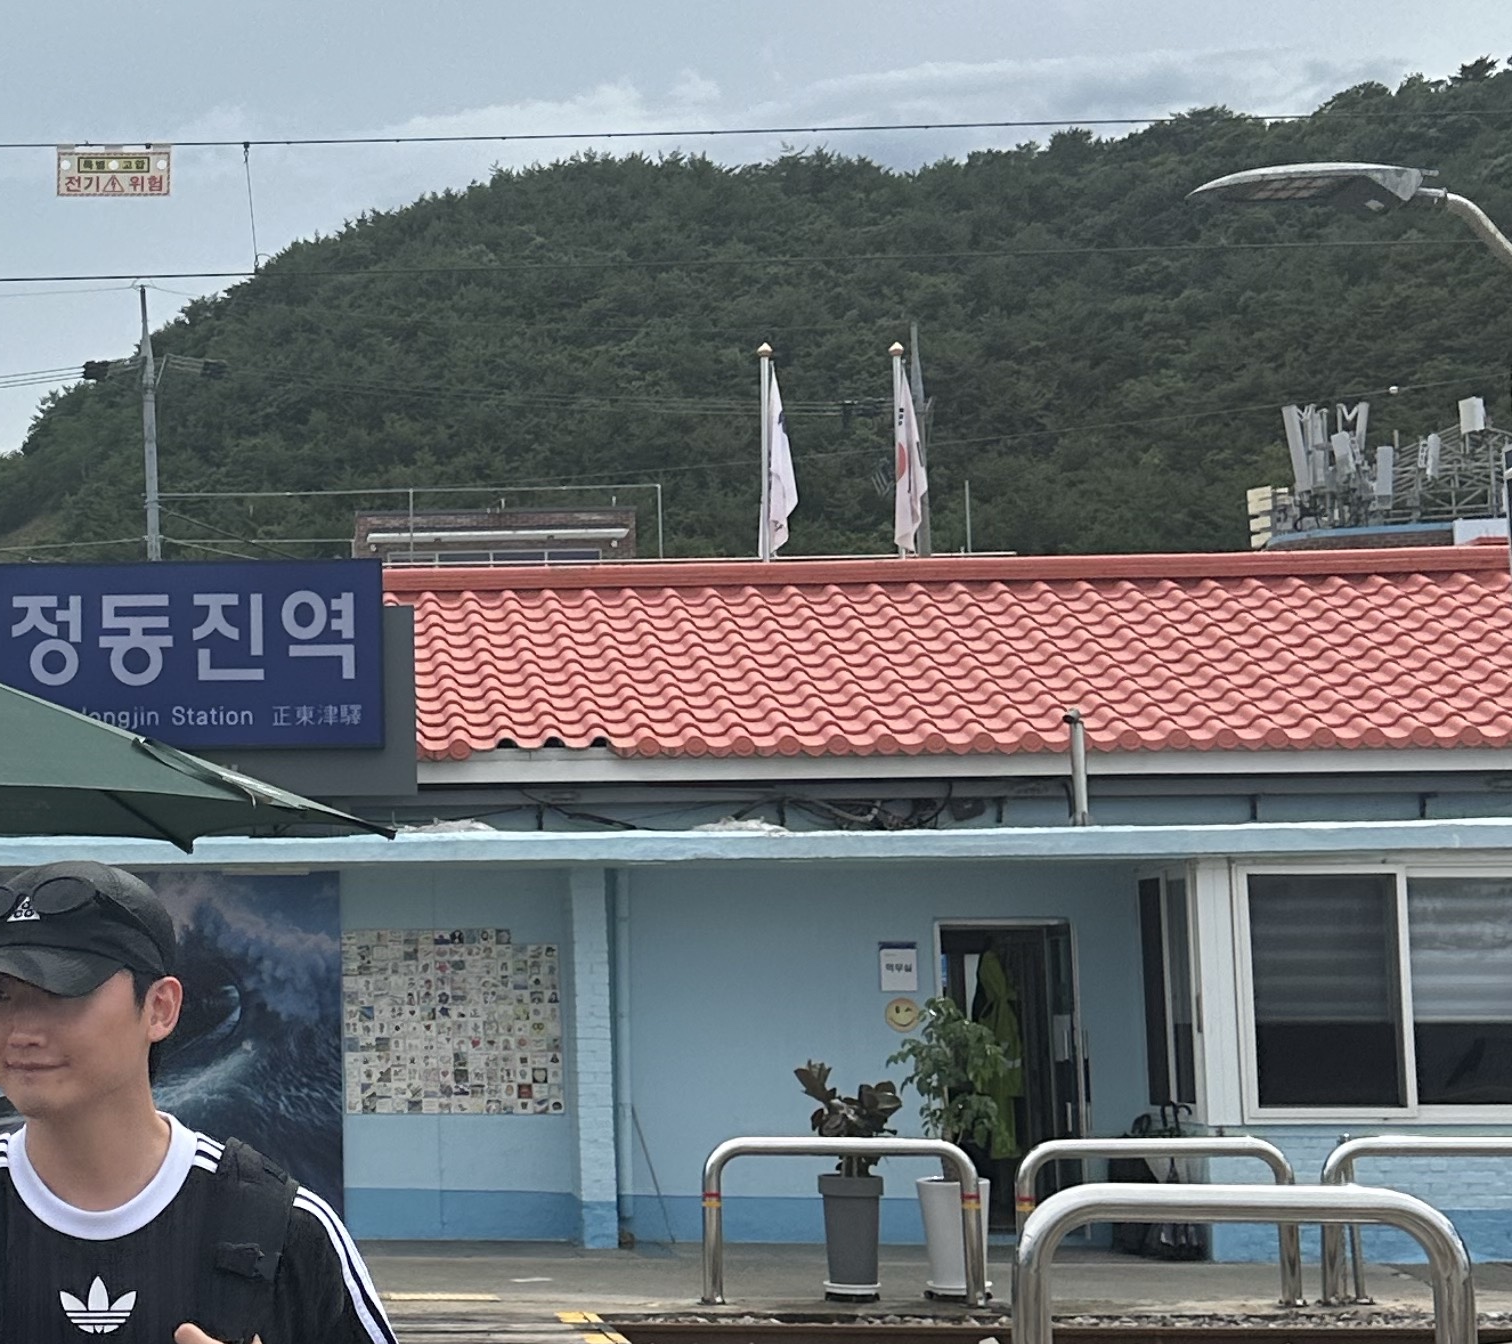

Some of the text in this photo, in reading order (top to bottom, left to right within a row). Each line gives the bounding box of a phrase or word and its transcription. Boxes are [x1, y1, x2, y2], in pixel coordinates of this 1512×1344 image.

[65, 175, 163, 193] 전기 위험
[10, 589, 357, 687] 정동진역
[171, 705, 255, 726] Station
[272, 704, 363, 727] 正東津驛
